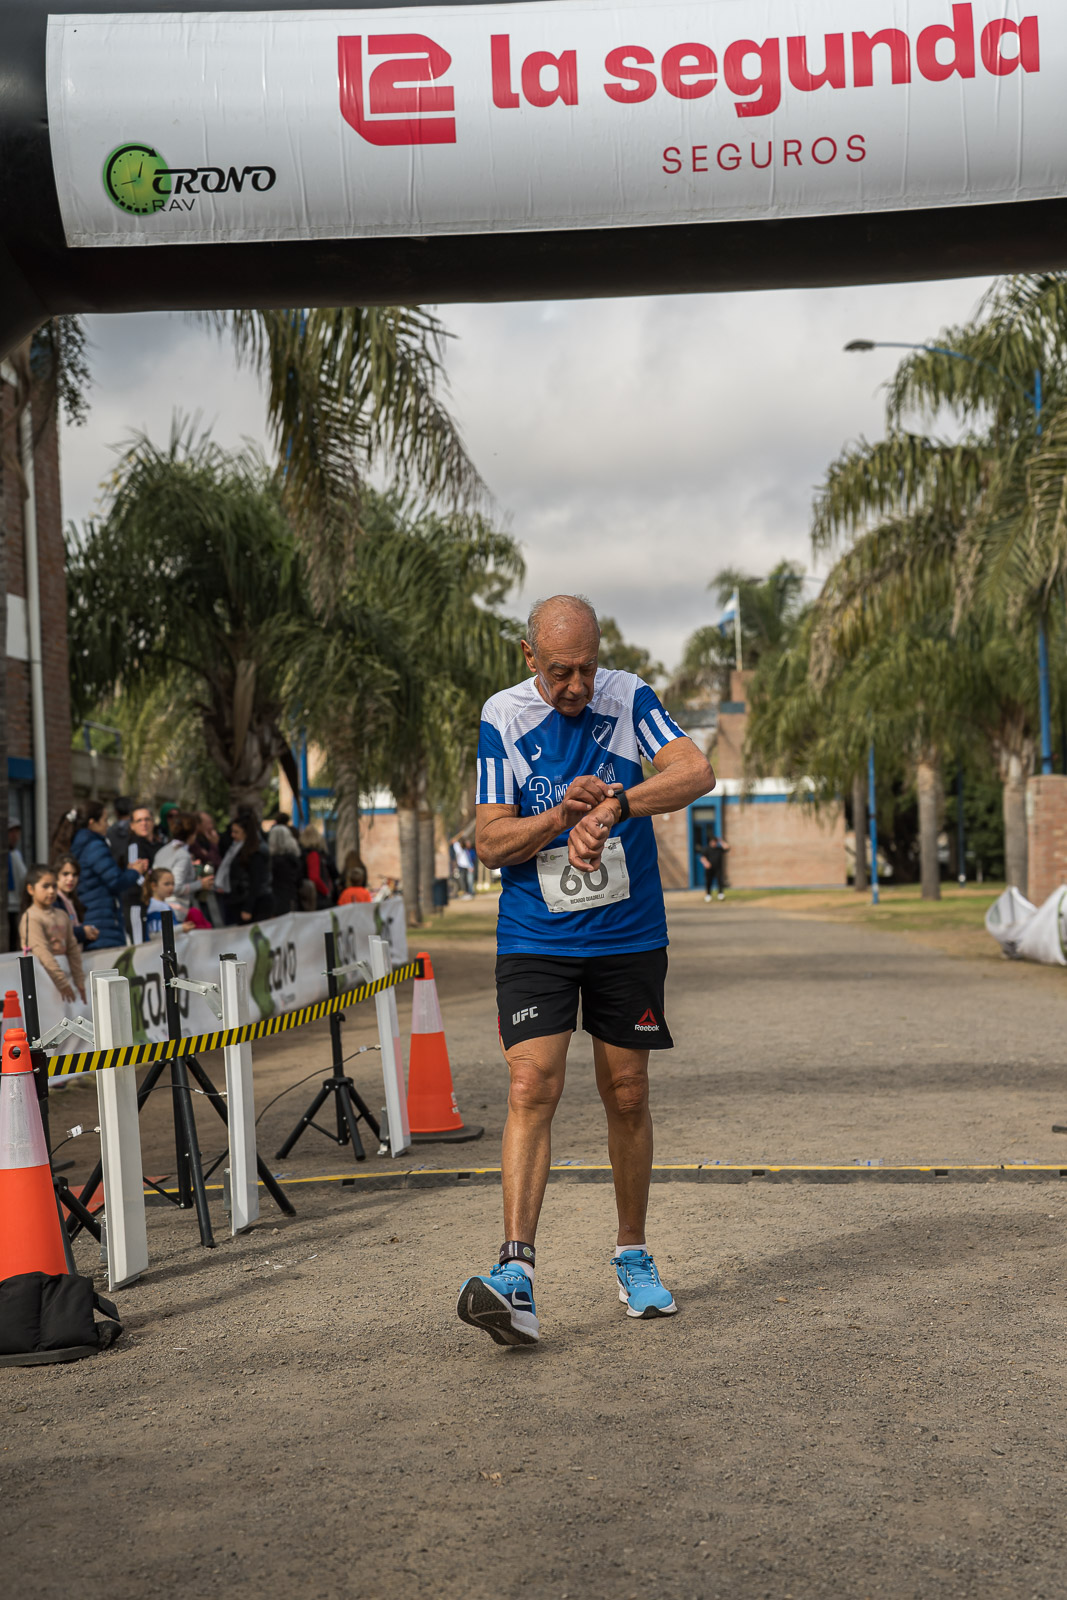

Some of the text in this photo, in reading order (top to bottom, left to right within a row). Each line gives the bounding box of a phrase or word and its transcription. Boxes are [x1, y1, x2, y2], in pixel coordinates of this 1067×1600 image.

[490, 2, 1041, 119] la segunda
[662, 134, 867, 175] SEGUROS
[152, 166, 276, 195] CRONO
[152, 199, 195, 212] RAV
[560, 861, 609, 896] 60
[512, 1005, 539, 1026] UFC
[634, 1024, 660, 1032] Reebok
